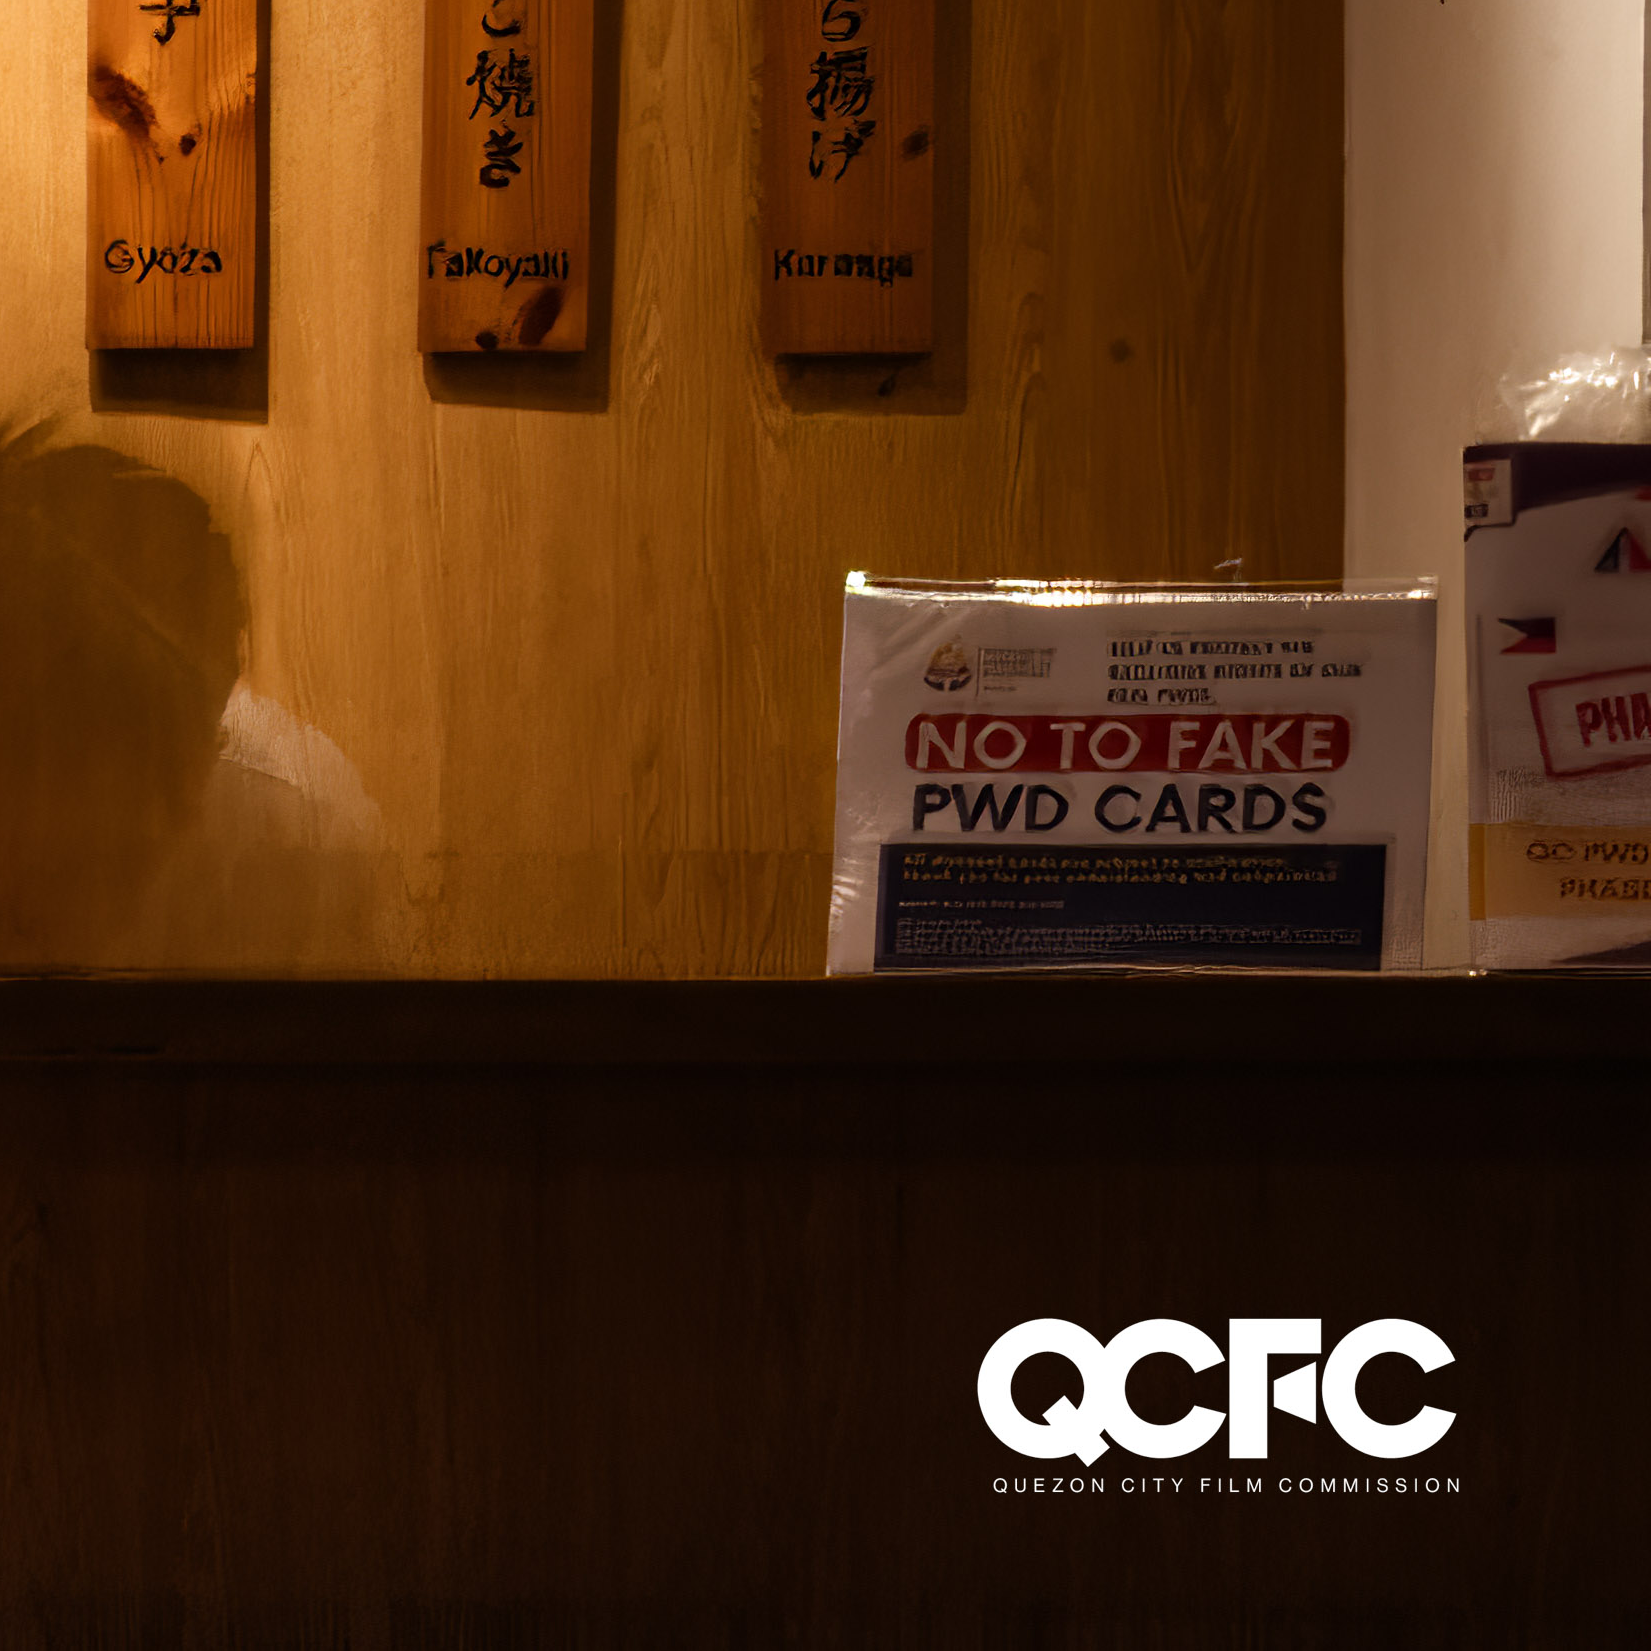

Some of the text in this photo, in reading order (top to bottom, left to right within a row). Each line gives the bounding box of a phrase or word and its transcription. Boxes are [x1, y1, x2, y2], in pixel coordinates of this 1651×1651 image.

[104, 238, 223, 283] Gyoza
[427, 240, 569, 288] Takoyaki
[916, 720, 1334, 770] NO TO FAKE
[912, 782, 1328, 833] PWD CARDS
